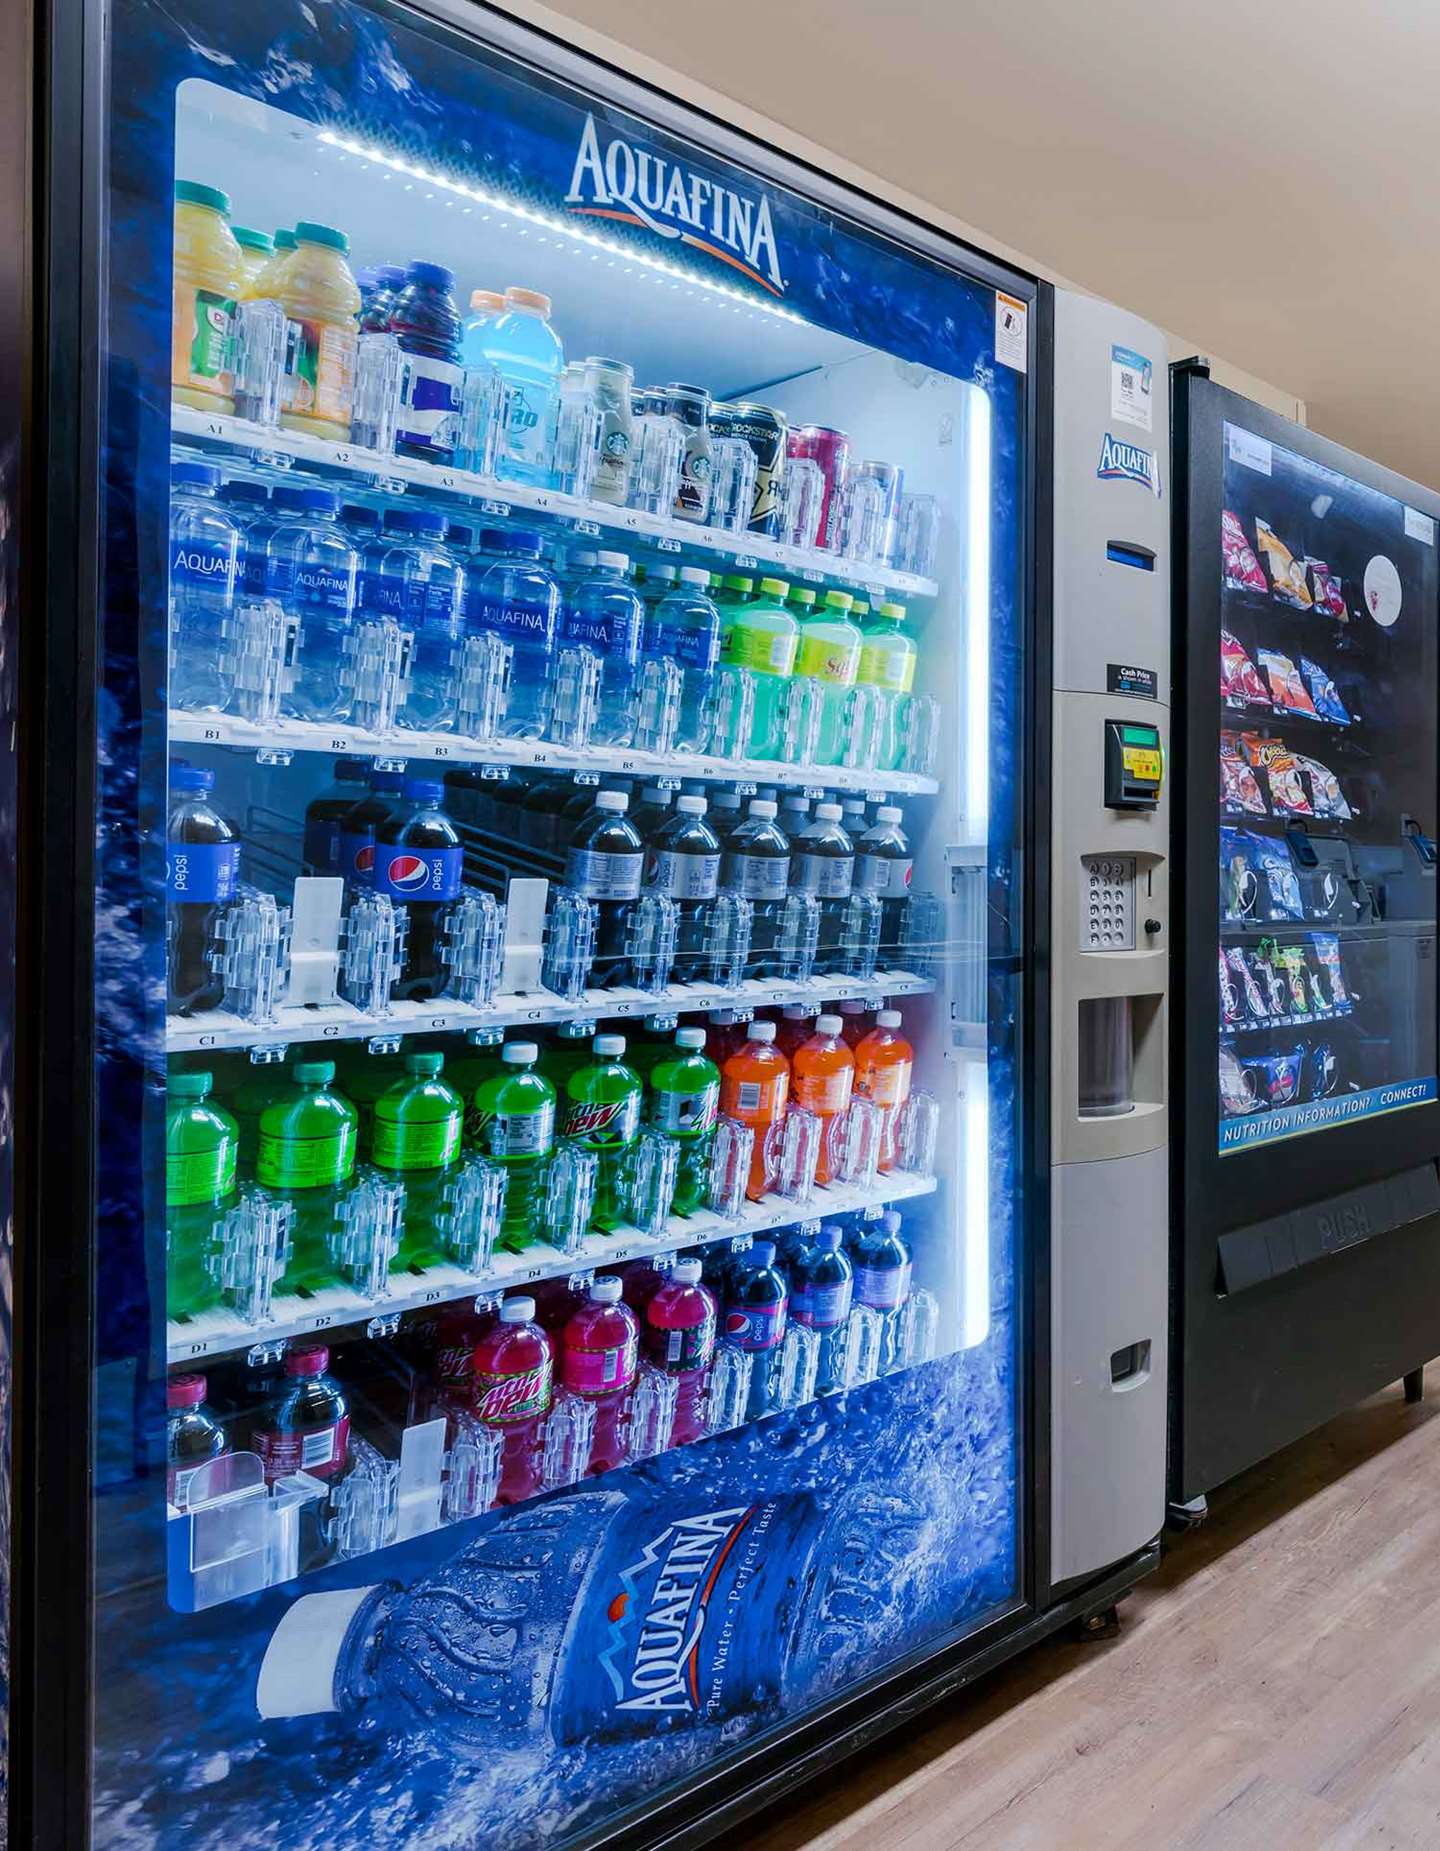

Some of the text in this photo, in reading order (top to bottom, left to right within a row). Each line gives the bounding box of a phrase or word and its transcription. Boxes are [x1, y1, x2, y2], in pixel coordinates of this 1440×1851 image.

[564, 111, 785, 291] AQUAFINA
[207, 424, 223, 435] A1
[336, 452, 350, 463] A2
[1099, 435, 1153, 478] AQUAFIN
[441, 477, 454, 487] A3
[295, 572, 349, 592] AQUAFINA
[1120, 667, 1151, 679] Cash Price
[204, 728, 220, 740] B1
[332, 739, 347, 750] B2
[435, 746, 448, 756] B3
[534, 753, 547, 763] B4
[622, 761, 634, 770] B5
[174, 854, 189, 890] pepsi
[432, 859, 444, 890] pepsi
[617, 1004, 630, 1013] C5
[700, 999, 711, 1007] C6
[528, 1011, 541, 1020] C4
[432, 1018, 446, 1028] C3
[323, 1026, 339, 1036] C2
[199, 1036, 216, 1046] C1
[1223, 1084, 1427, 1142] NUTRITION INFORMATION? CONNECT!
[1318, 1203, 1371, 1246] PUSH
[615, 1250, 628, 1259] D5
[528, 1268, 542, 1279] D4
[426, 1291, 440, 1301] D3
[315, 1316, 331, 1327] D2
[191, 1342, 208, 1354] D1
[752, 1502, 777, 1536] Taste
[728, 1541, 760, 1601] Perfect
[615, 1507, 749, 1712] AQUAFINA
[713, 1621, 734, 1672] Water
[706, 1678, 723, 1710] Pure
